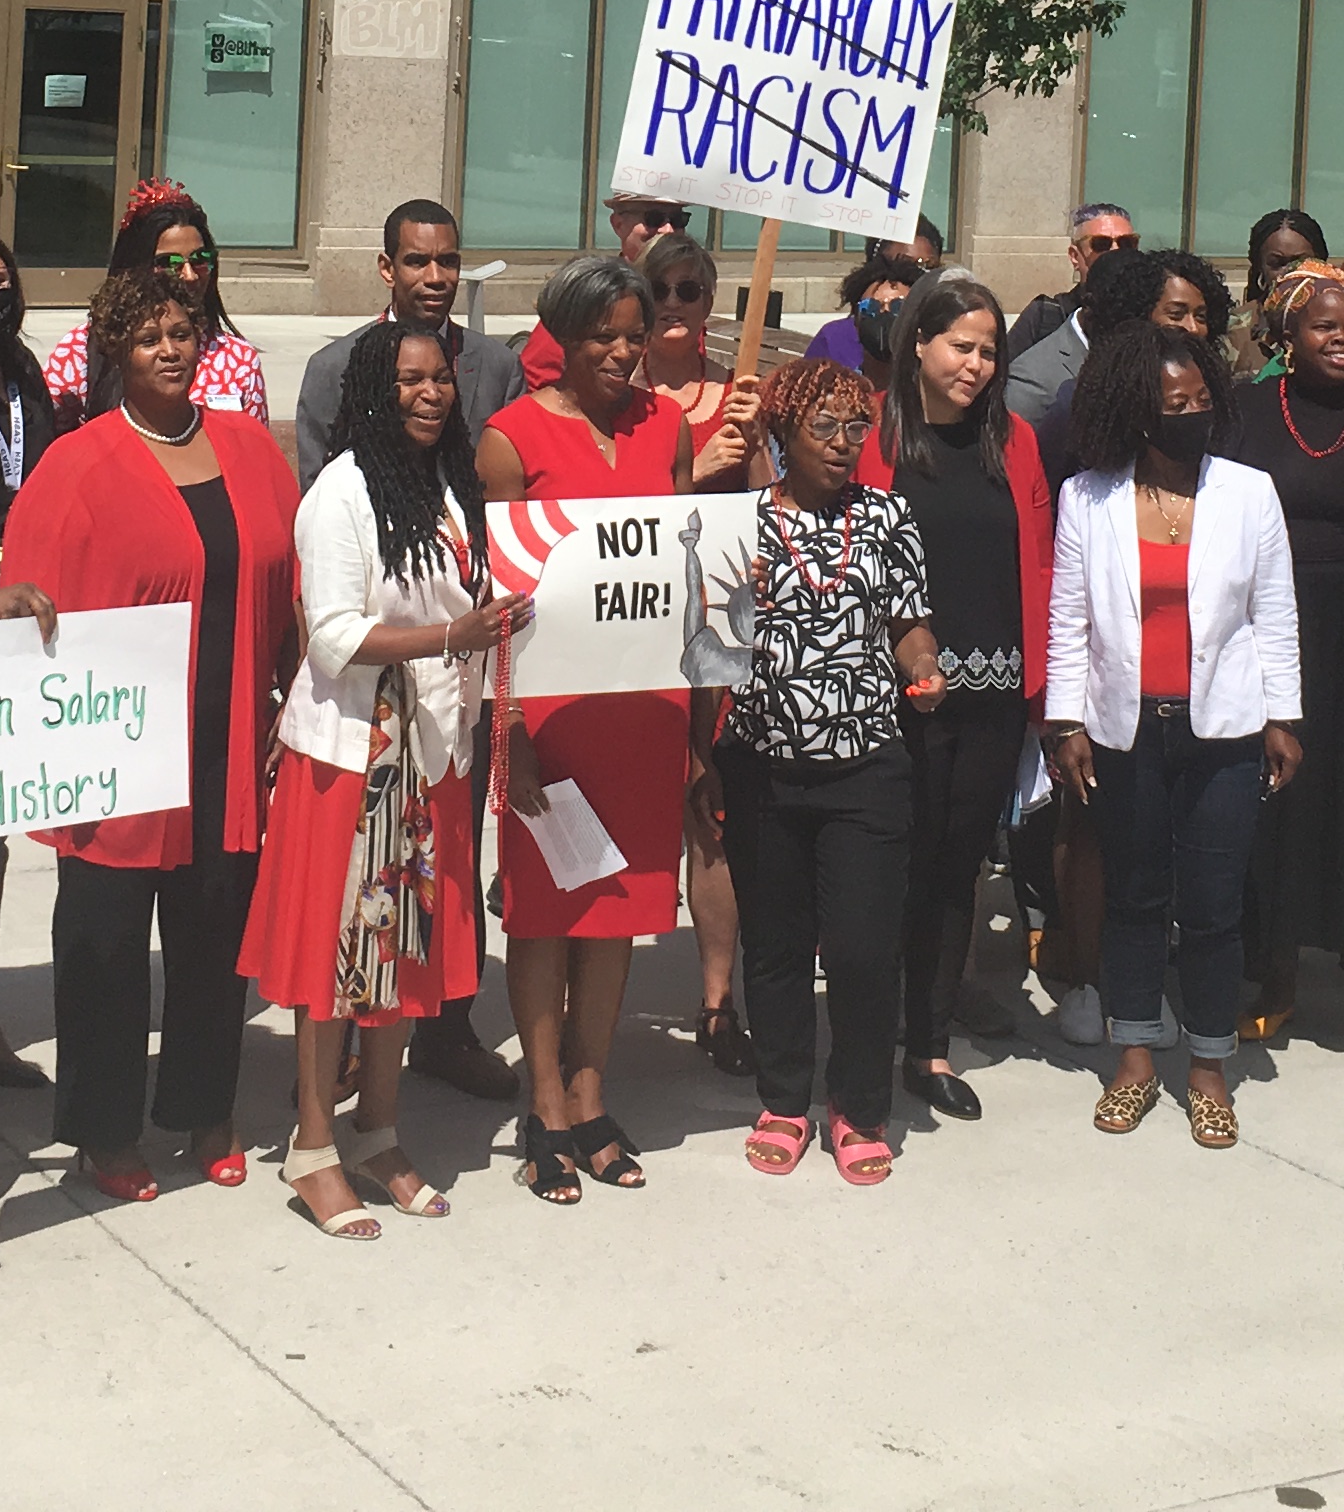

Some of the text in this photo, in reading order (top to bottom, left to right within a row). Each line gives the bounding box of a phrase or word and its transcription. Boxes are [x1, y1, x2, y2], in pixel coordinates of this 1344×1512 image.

[643, 49, 917, 211] RACISM
[619, 164, 904, 235] STOP IT STOP IT STOP IT
[596, 517, 661, 560] NOT
[594, 581, 671, 622] FAIR!
[40, 669, 146, 741] Salary
